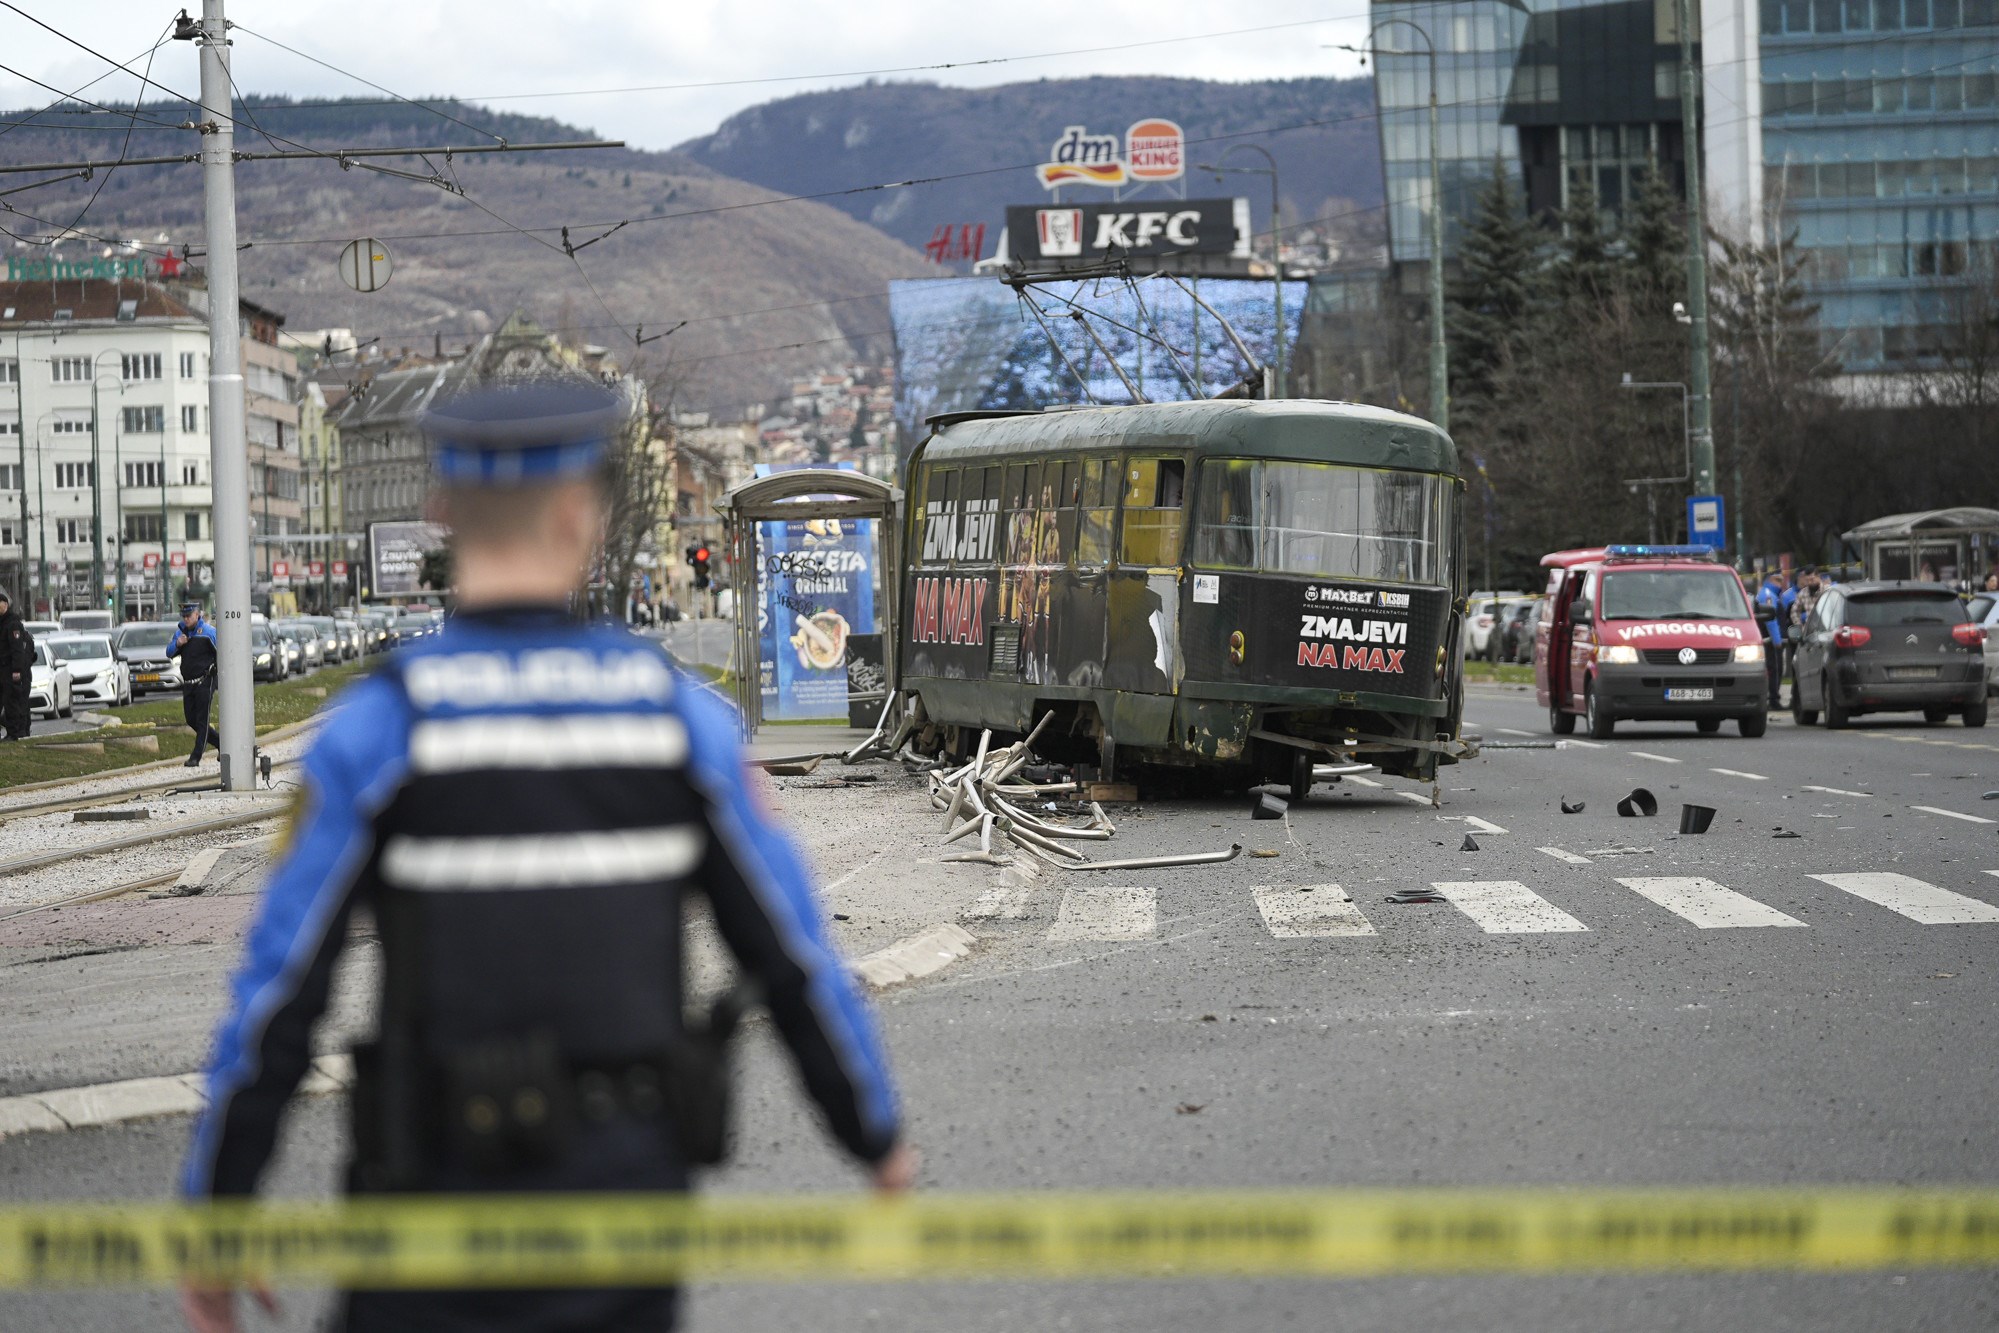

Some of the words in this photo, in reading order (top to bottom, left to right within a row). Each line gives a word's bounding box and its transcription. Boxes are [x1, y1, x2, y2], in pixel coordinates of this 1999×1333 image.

[1058, 131, 1112, 163] dm
[1131, 152, 1179, 166] KING
[1092, 211, 1201, 248] KFC
[8, 255, 144, 281] Heineken
[795, 577, 848, 594] ORIGINAL
[225, 611, 241, 619] 200
[913, 577, 939, 643] NA
[941, 577, 987, 645] MAX
[1300, 615, 1408, 645] ZMAJEVI
[1618, 623, 1742, 640] VATROGASCI
[1297, 641, 1338, 669] NA
[1342, 645, 1406, 673] MAX
